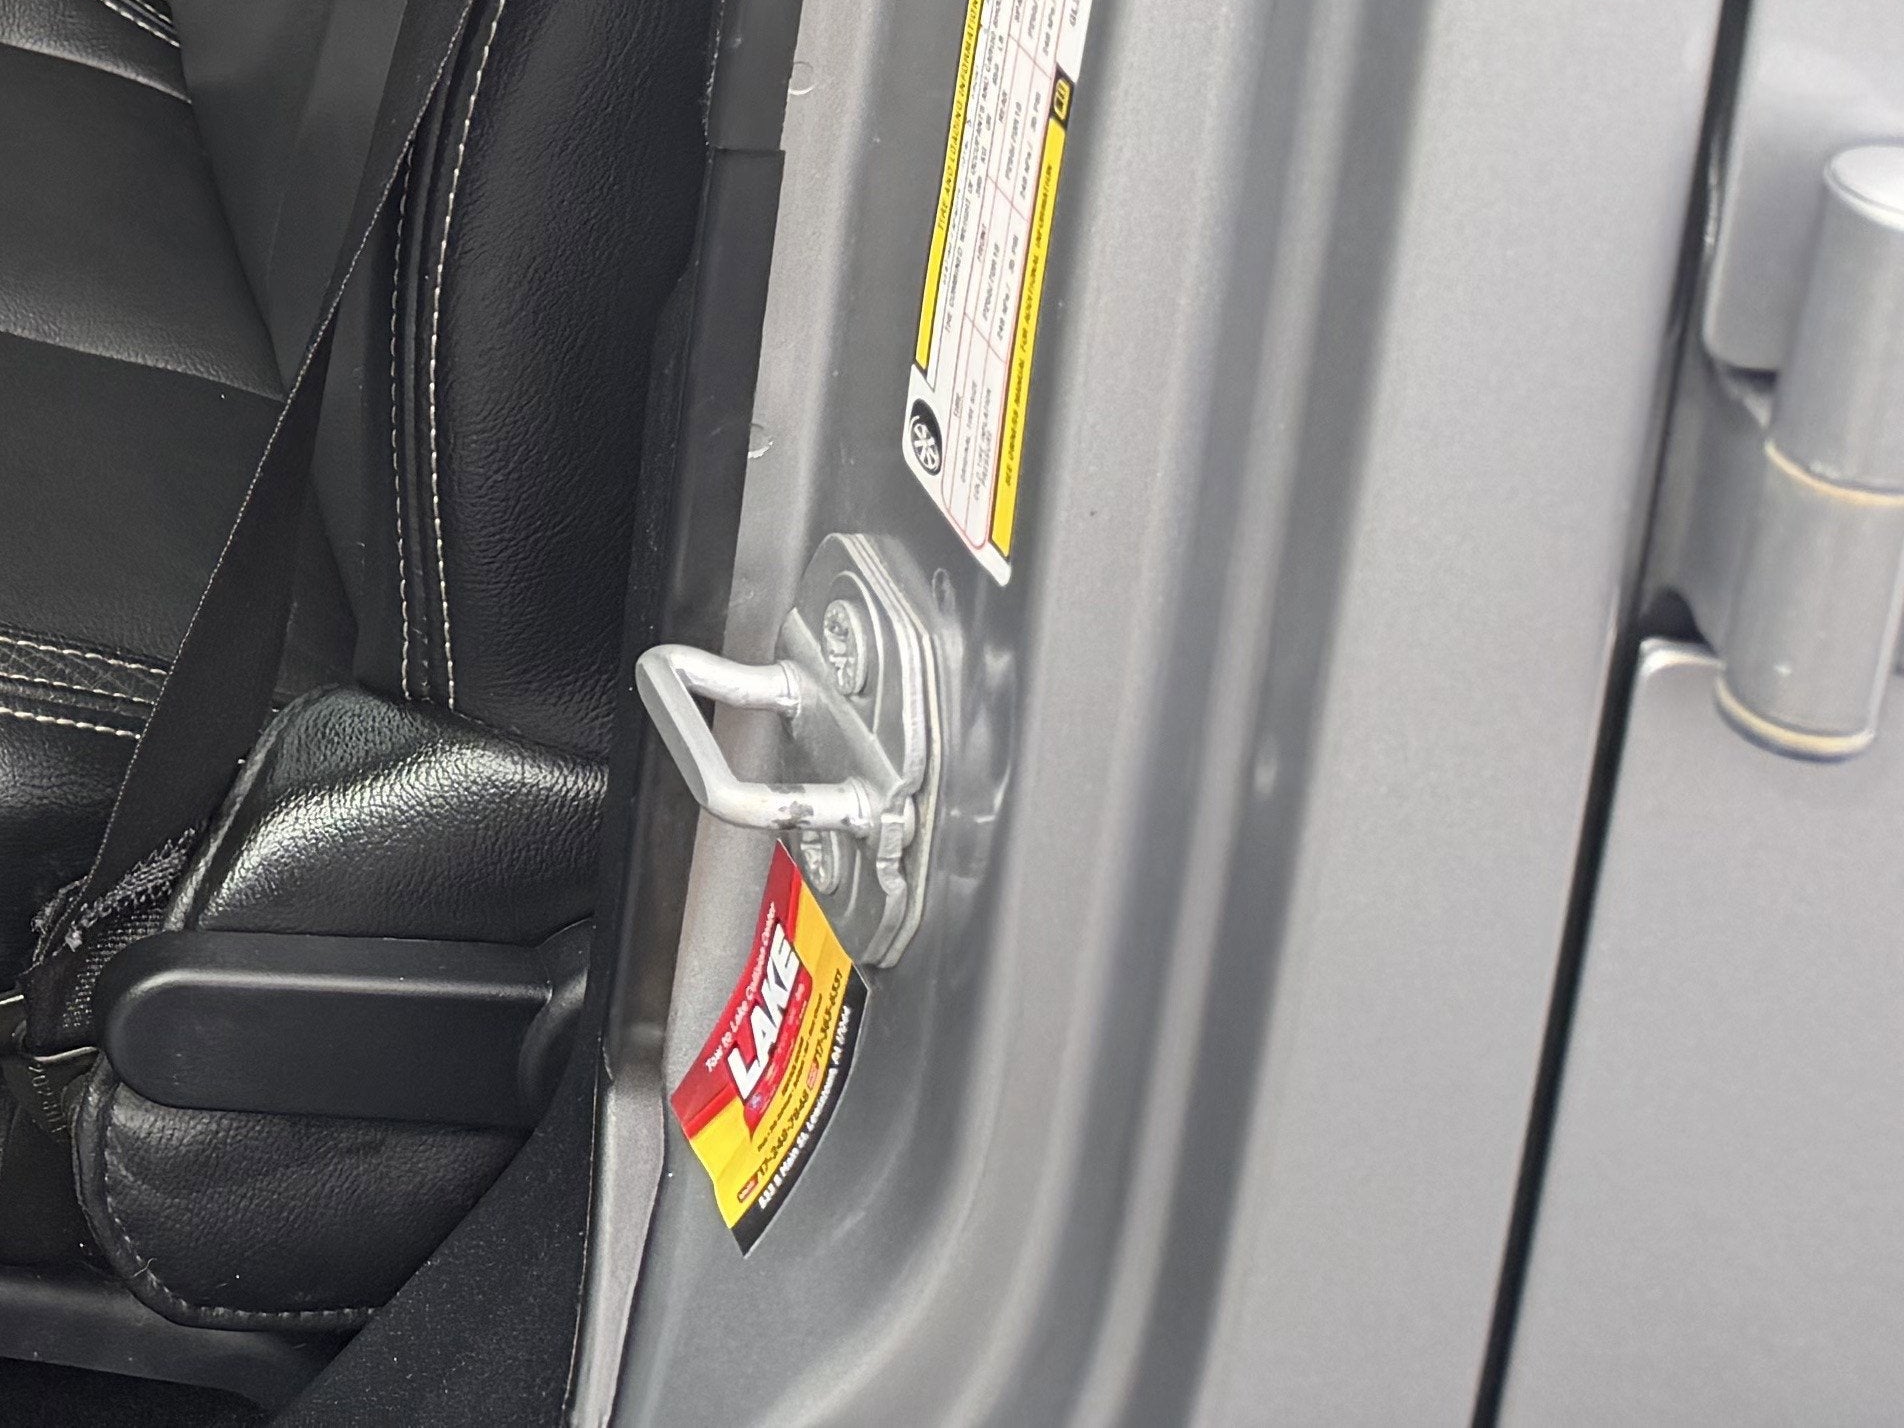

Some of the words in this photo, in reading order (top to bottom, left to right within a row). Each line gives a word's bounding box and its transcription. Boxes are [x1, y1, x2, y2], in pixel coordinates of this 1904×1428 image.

[947, 97, 963, 164] LOADING
[943, 162, 954, 198] AND
[936, 196, 948, 233] TIRE
[706, 1045, 723, 1072] Tow
[722, 1031, 732, 1047] to
[730, 1000, 748, 1032] Lake
[727, 922, 800, 1100] LAKE
